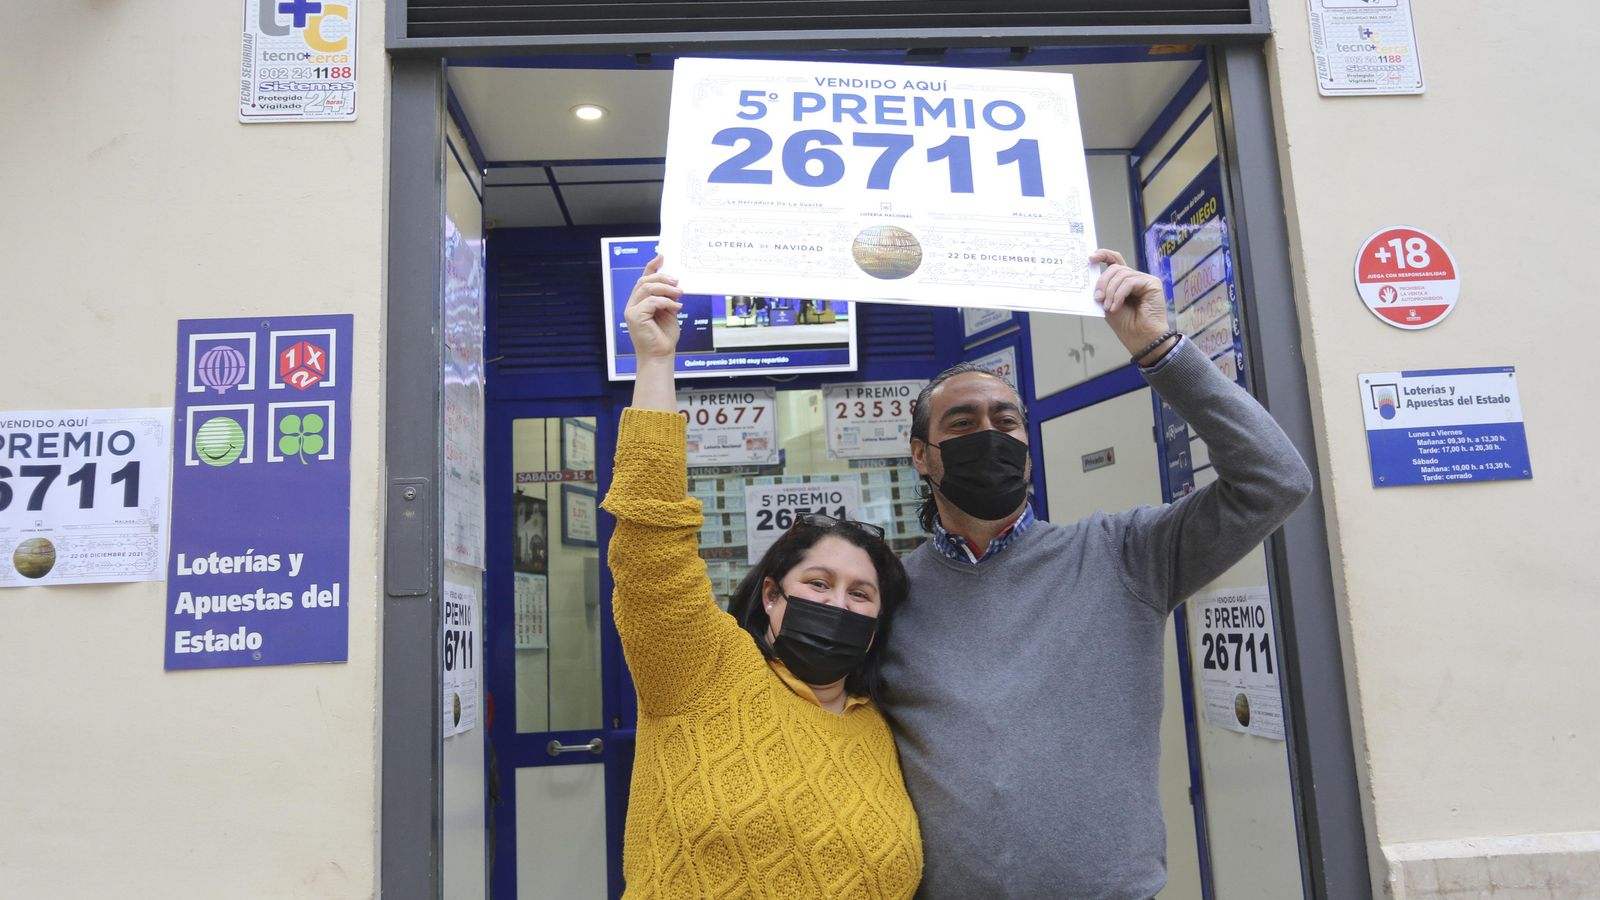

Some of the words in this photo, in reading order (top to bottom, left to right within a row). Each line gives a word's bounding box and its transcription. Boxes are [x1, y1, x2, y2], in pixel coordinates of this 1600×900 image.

[242, 33, 253, 78] SEGURIDAD
[260, 68, 288, 79] 902
[259, 81, 354, 92] Sistemas
[814, 76, 897, 89] VENDIDO
[903, 80, 947, 91] AQUÍ
[241, 82, 251, 105] TECNO
[793, 92, 1026, 131] PREMIO
[707, 127, 1045, 197] 26711
[774, 244, 823, 252] NAVIDAD
[1374, 237, 1430, 269] +18
[981, 254, 1037, 263] DICIEMBRE
[1041, 257, 1064, 265] 2021
[286, 349, 295, 369] 1
[306, 345, 323, 371] X
[684, 359, 705, 367] Quinto
[706, 359, 727, 367] premio
[761, 356, 789, 364] repartido
[857, 386, 910, 399] PREMIO
[1404, 384, 1446, 396] Loterías
[1449, 386, 1455, 396] y
[700, 393, 755, 405] PREMIO
[1406, 398, 1454, 410] Apuestas
[1458, 395, 1473, 405] del
[1477, 394, 1511, 405] Estado
[835, 399, 917, 419] 23538
[58, 417, 89, 428] AQUÍ
[1437, 429, 1463, 437] Viernes
[1417, 438, 1446, 446] Mañana:
[1412, 457, 1439, 465] Sábado
[1421, 465, 1450, 473] Mañana:
[1486, 462, 1503, 470] 13,30
[573, 471, 586, 480] 15
[1422, 473, 1445, 481] Tarde:
[1446, 472, 1472, 480] cerrado
[777, 492, 842, 506] PREMIO
[177, 549, 281, 576] Loterías
[288, 553, 304, 577] y
[174, 588, 293, 620] Apuestas
[302, 583, 340, 608] del
[1214, 605, 1265, 628] PREMIO
[174, 626, 263, 654] Estado
[1202, 632, 1273, 674] 26711
